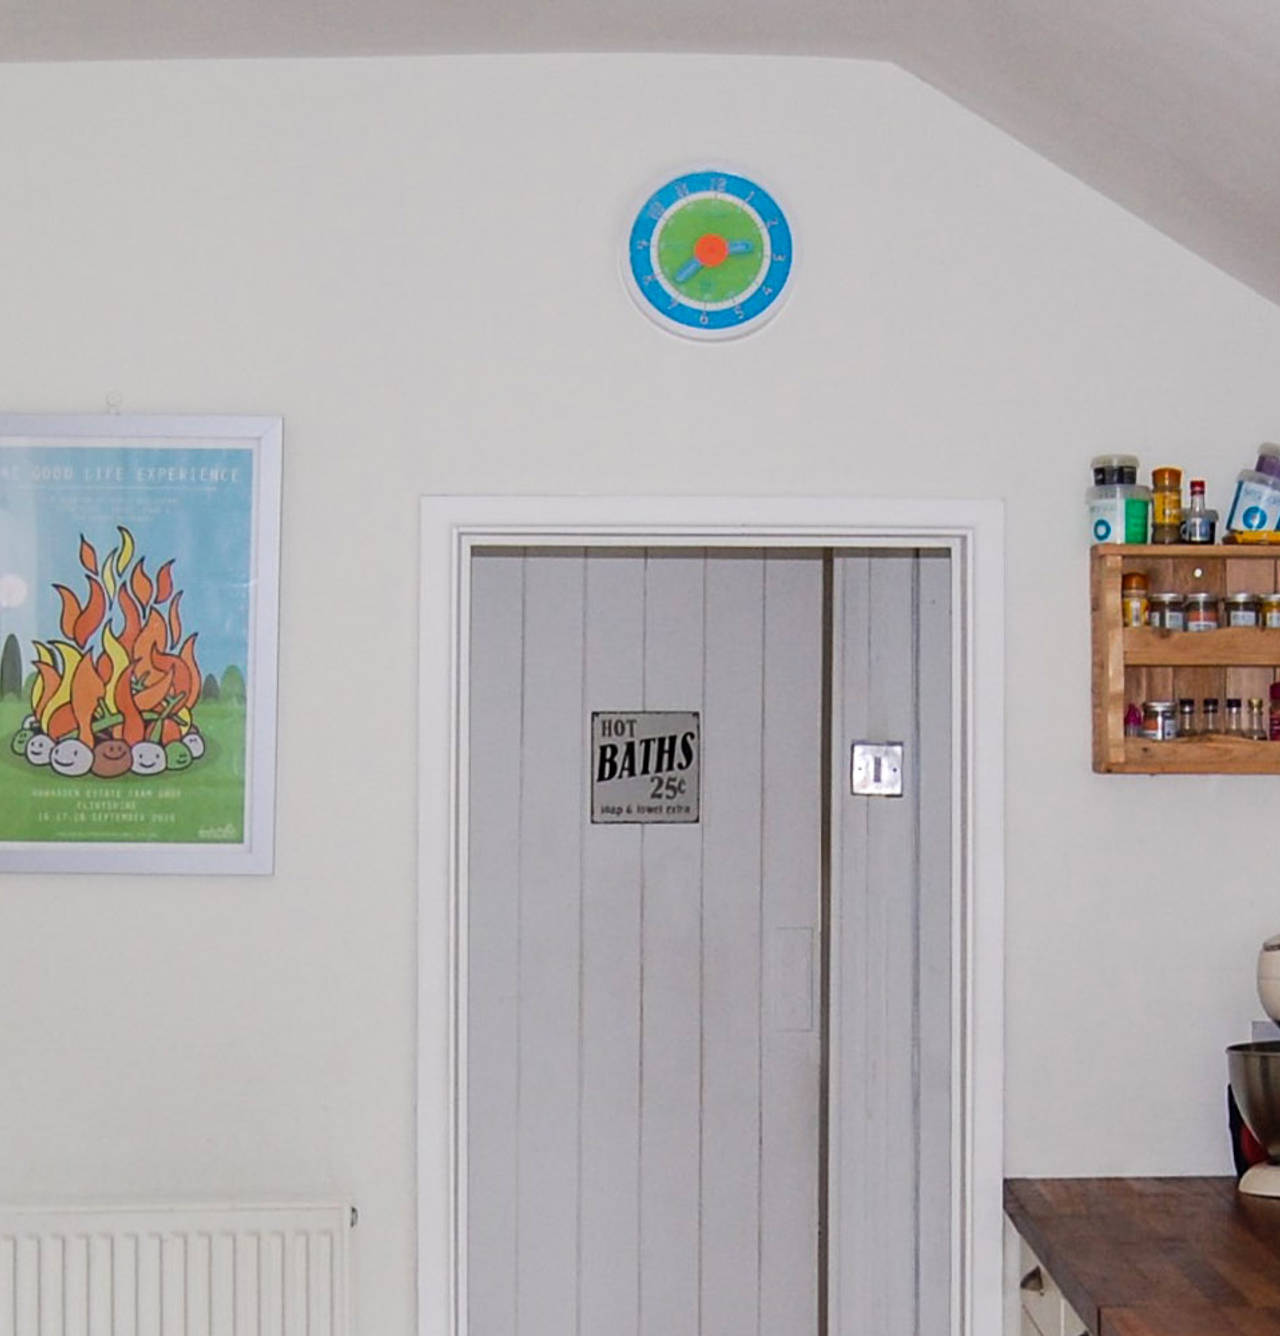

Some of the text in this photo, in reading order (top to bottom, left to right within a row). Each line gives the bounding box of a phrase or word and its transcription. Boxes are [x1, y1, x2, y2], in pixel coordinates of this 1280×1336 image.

[135, 465, 240, 483] EXPERIENCE
[601, 718, 637, 738] HOT
[596, 731, 695, 783] BATHS
